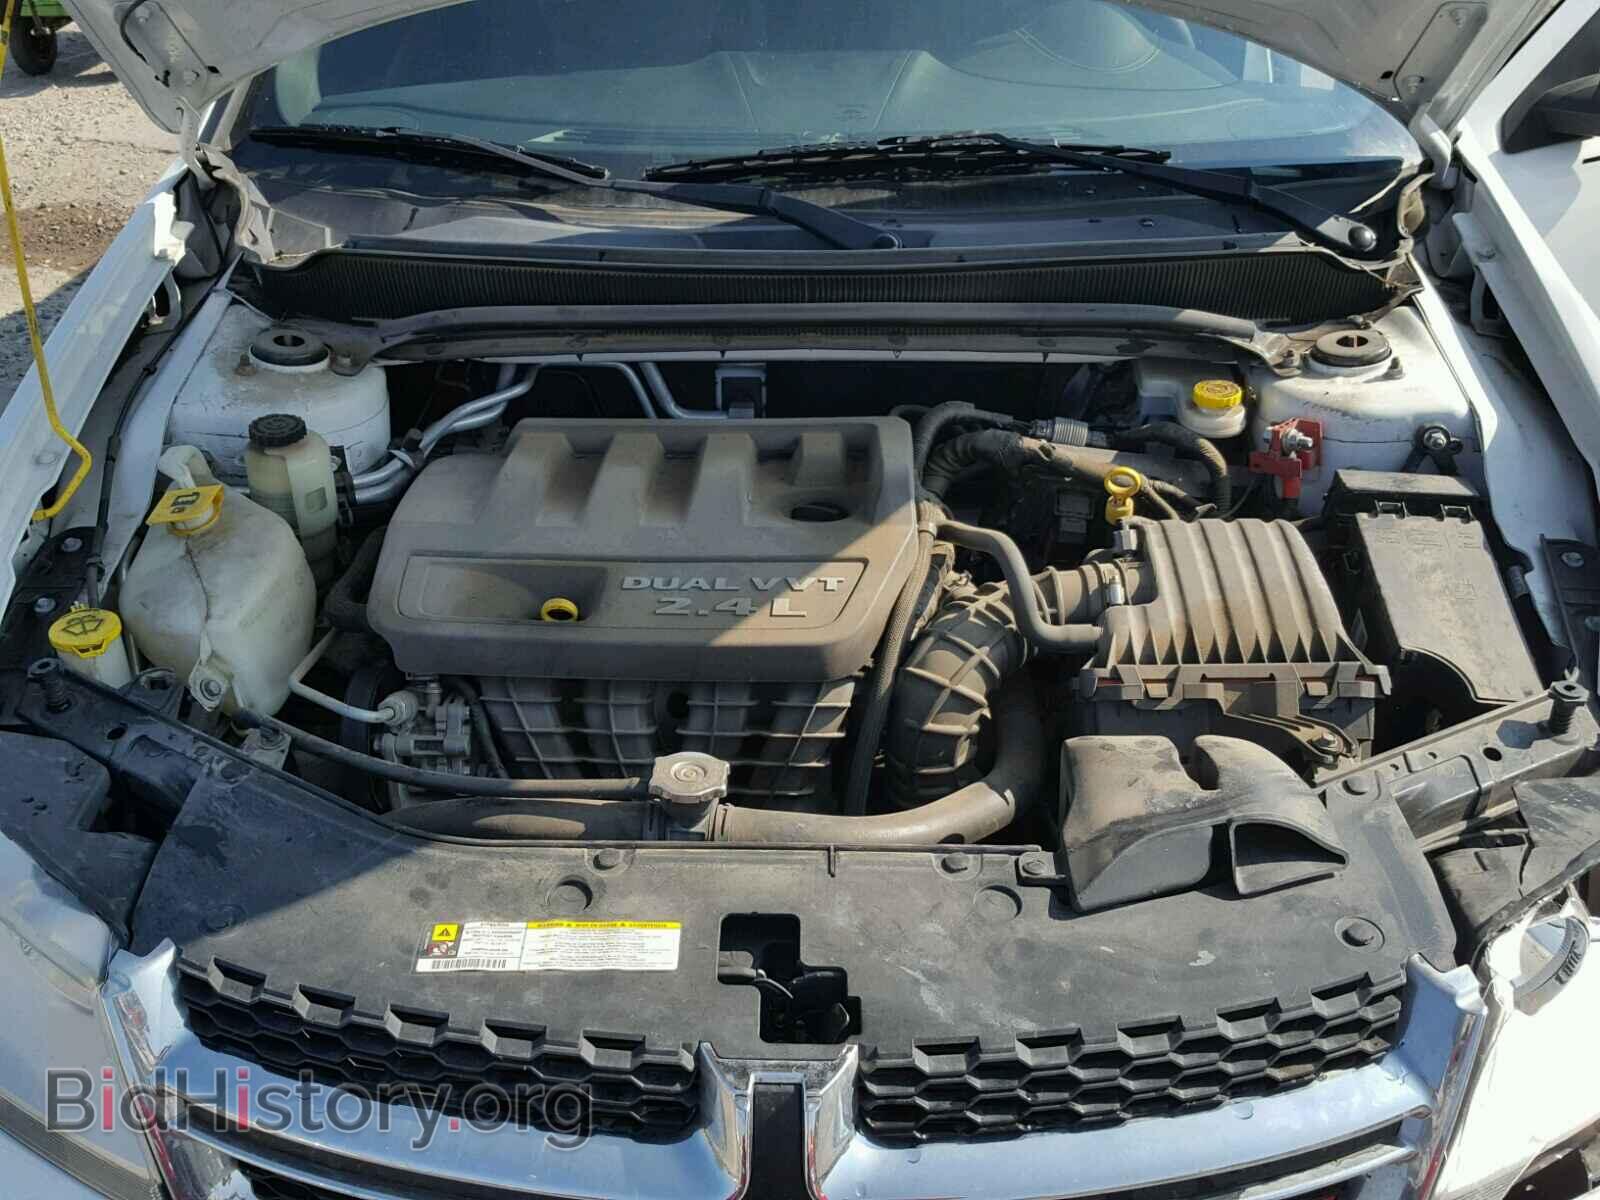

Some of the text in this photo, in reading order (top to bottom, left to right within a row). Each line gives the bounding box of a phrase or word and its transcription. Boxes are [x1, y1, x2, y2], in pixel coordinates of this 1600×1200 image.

[621, 576, 845, 591] DUAL VVT
[654, 597, 807, 617] 2.4L
